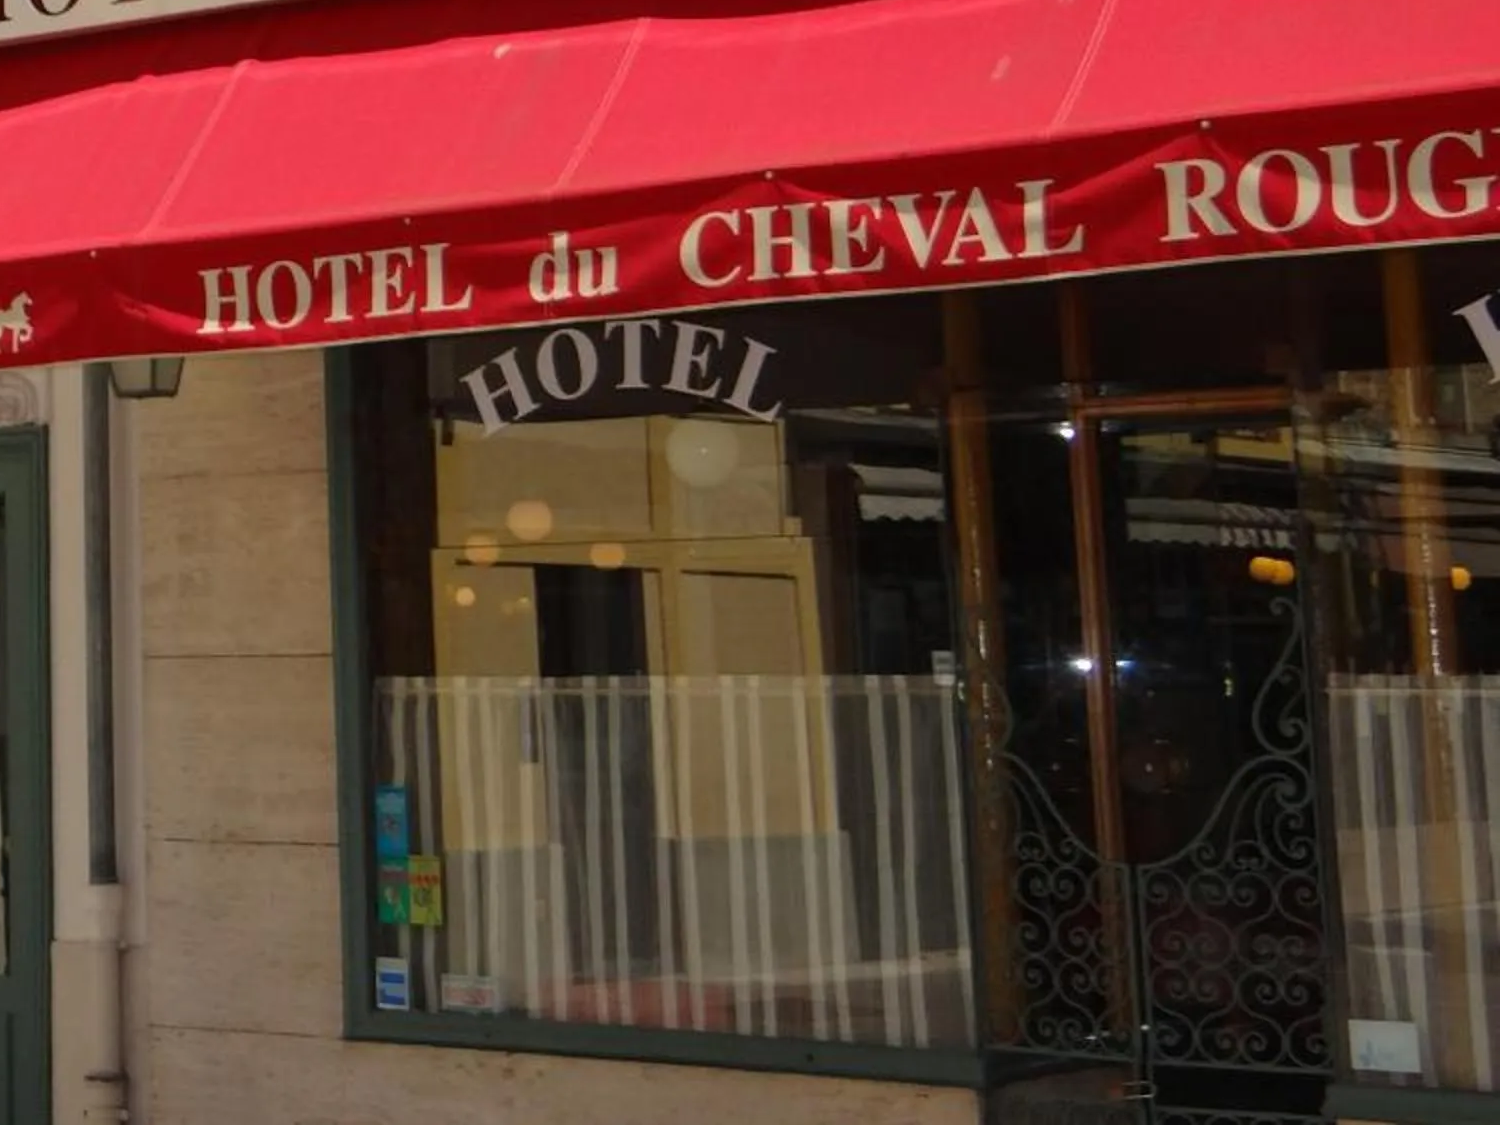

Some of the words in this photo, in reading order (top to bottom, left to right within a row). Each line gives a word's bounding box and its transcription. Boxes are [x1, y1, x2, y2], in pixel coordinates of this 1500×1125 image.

[196, 242, 473, 335] HOTEL
[528, 232, 619, 304] du
[679, 179, 1086, 289] CHEVAL
[1154, 127, 1500, 243] ROUG
[460, 319, 783, 436] HOTEL
